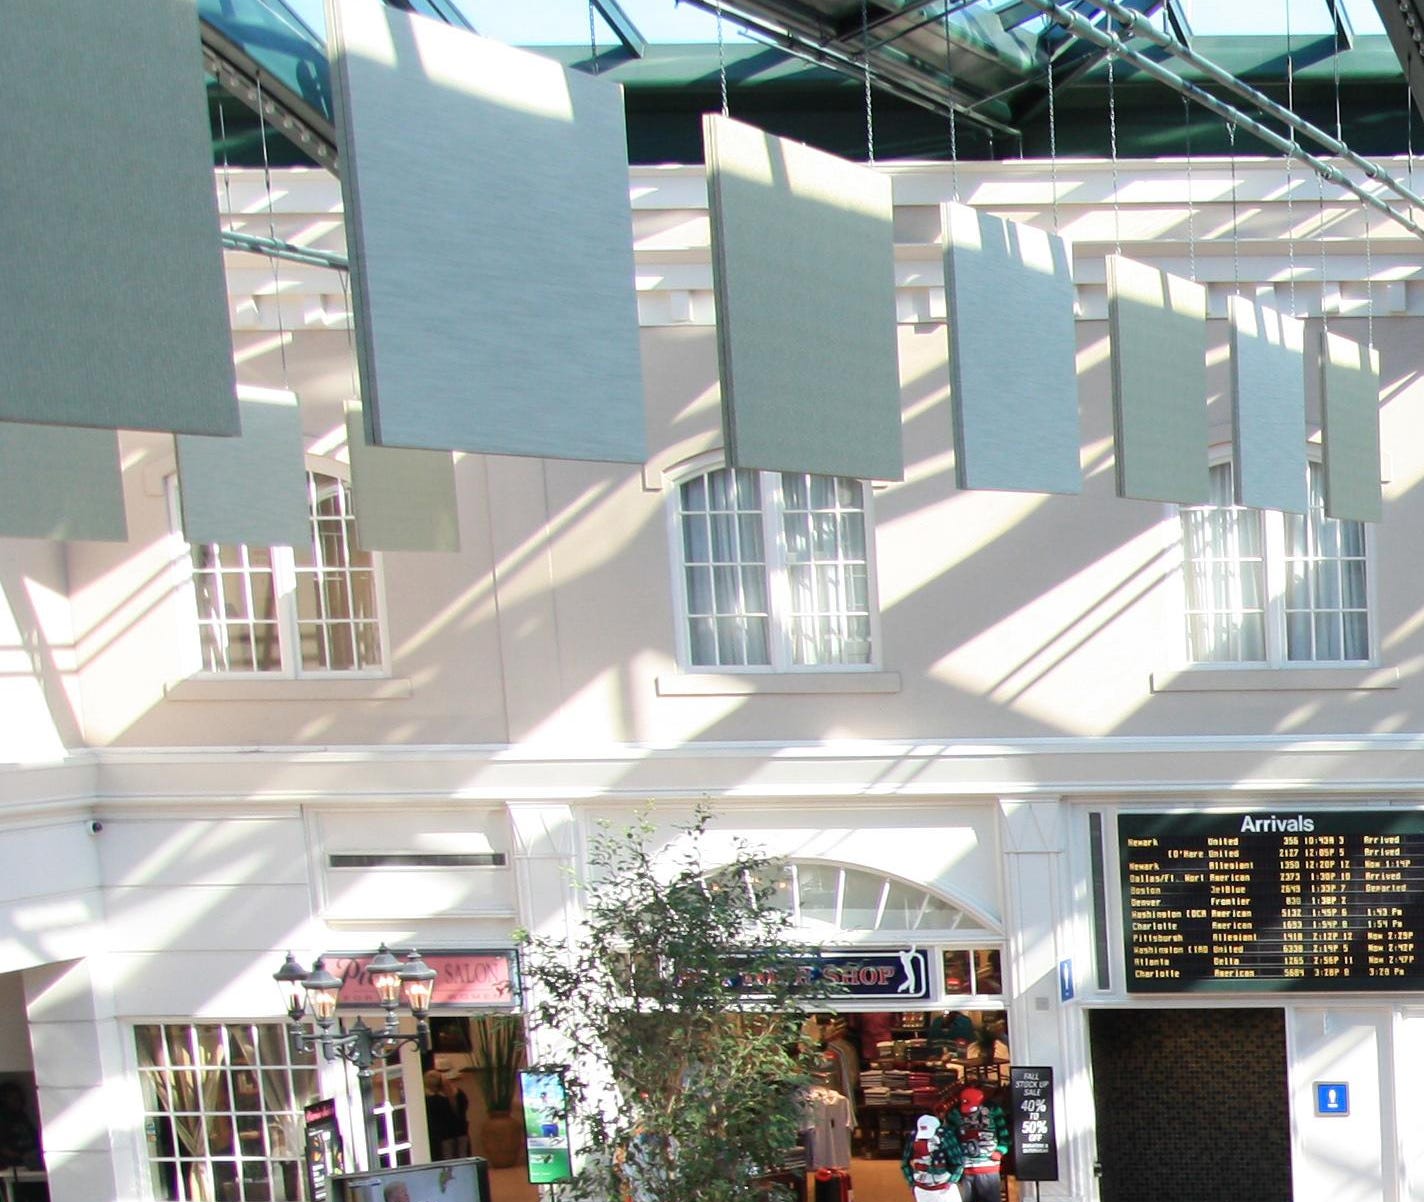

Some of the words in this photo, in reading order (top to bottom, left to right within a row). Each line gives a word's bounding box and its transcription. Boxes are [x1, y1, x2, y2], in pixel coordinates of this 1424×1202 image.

[1240, 815, 1315, 832] Arrivals
[1207, 837, 1239, 846] United
[1339, 836, 1345, 844] 3
[1363, 836, 1400, 844] Arrived
[1208, 850, 1240, 858] United
[1279, 849, 1299, 857] 2127
[1339, 848, 1345, 857] 5
[1364, 848, 1401, 856] Arrived
[1128, 862, 1160, 871] Newark
[1340, 860, 1350, 869] 12
[1209, 874, 1251, 882] American
[1365, 872, 1401, 880] Arrived
[1130, 886, 1161, 894] Boston
[1210, 886, 1246, 894] JetBlue
[1131, 898, 1162, 907] Denver
[1210, 897, 1251, 906] Frontier
[1131, 910, 1182, 919] Washington
[1211, 909, 1252, 918] American
[1132, 922, 1178, 931] Charlotte
[1211, 922, 1253, 930] American
[1133, 934, 1184, 943] Pittsburgh
[1212, 933, 1257, 942] Allegiant
[1343, 932, 1353, 940] 12
[1133, 946, 1184, 955] Washington
[1213, 945, 1244, 954] United
[1343, 944, 1349, 952] 5
[1134, 958, 1170, 966] Atlanta
[1213, 957, 1240, 966] Delta
[1344, 956, 1353, 964] 11
[444, 961, 497, 984] SALON
[823, 966, 896, 986] SHOP
[1135, 970, 1180, 978] Charlotte
[1214, 969, 1255, 977] American
[1021, 1099, 1047, 1112] 40%
[1029, 1112, 1039, 1120] TO
[1021, 1120, 1048, 1134] 50%
[1028, 1134, 1042, 1142] OFF
